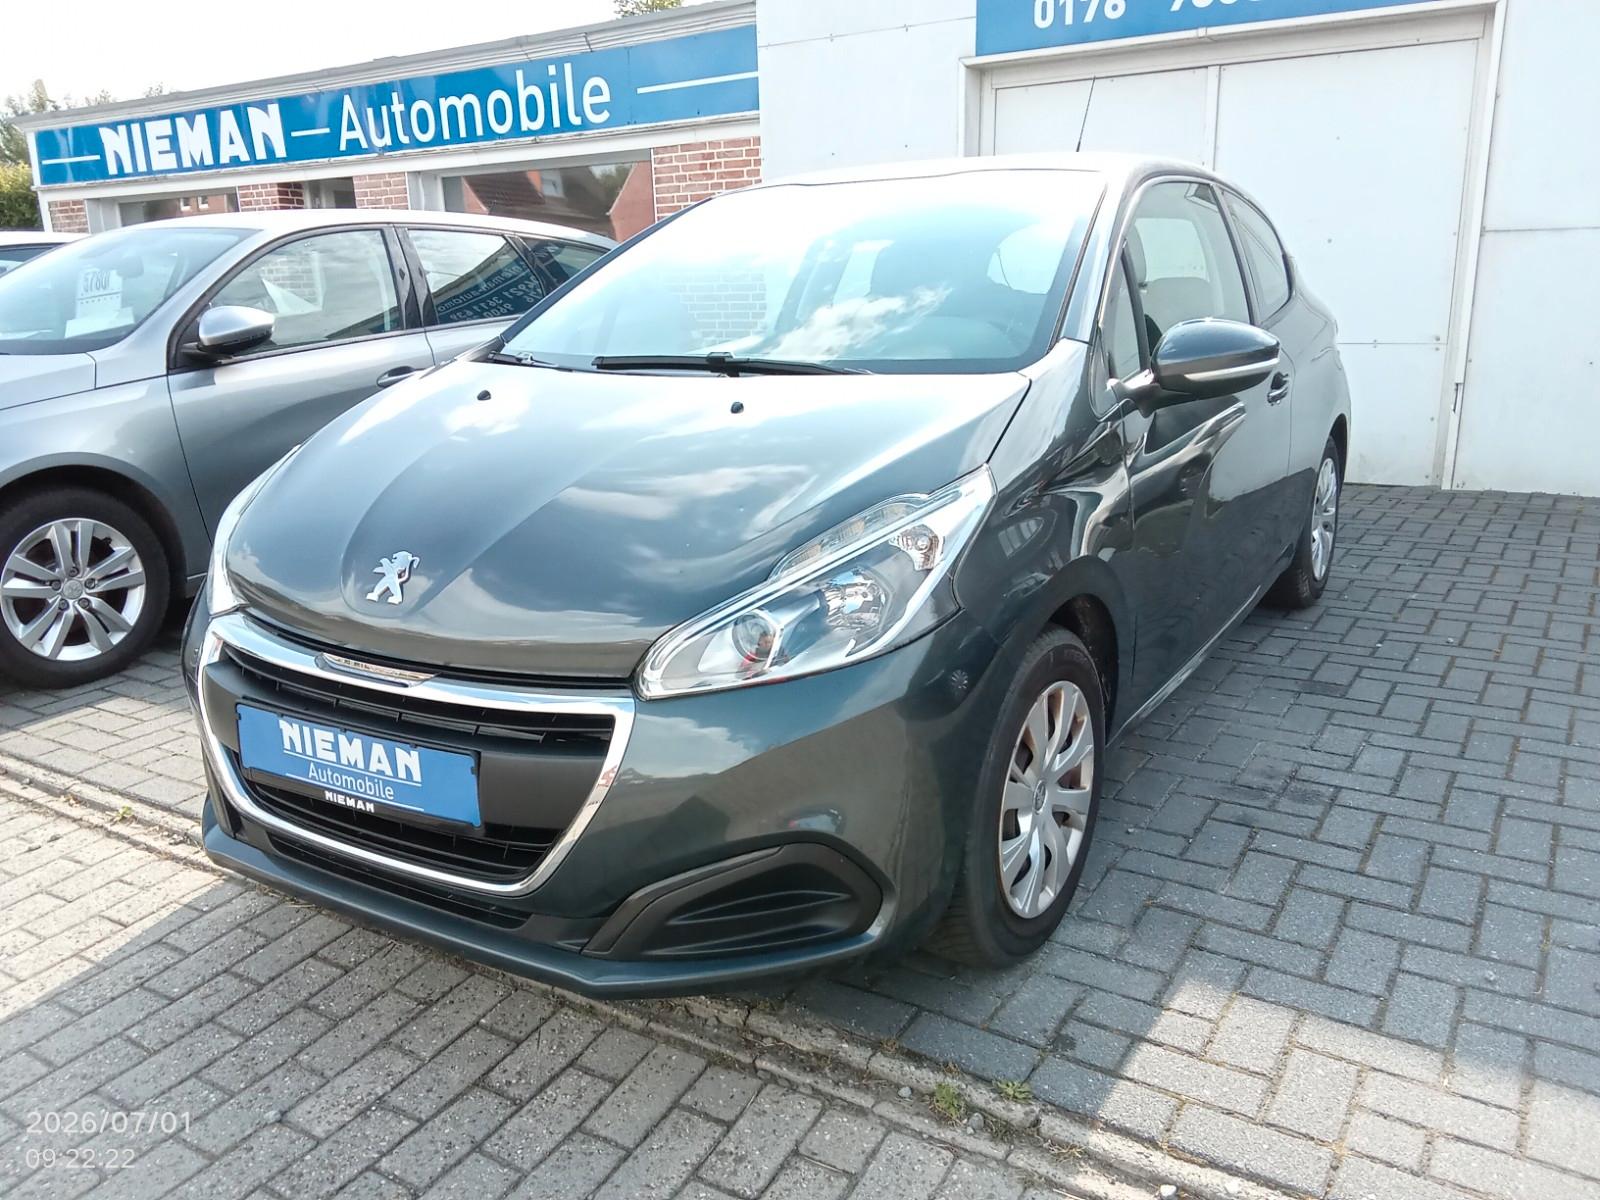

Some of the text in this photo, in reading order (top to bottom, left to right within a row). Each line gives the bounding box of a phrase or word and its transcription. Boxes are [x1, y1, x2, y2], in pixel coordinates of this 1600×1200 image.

[98, 63, 611, 175] NIEMAN Automobile
[279, 718, 422, 782] NIEMAN
[308, 763, 395, 800] Automobile
[324, 790, 375, 813] NIEMAN
